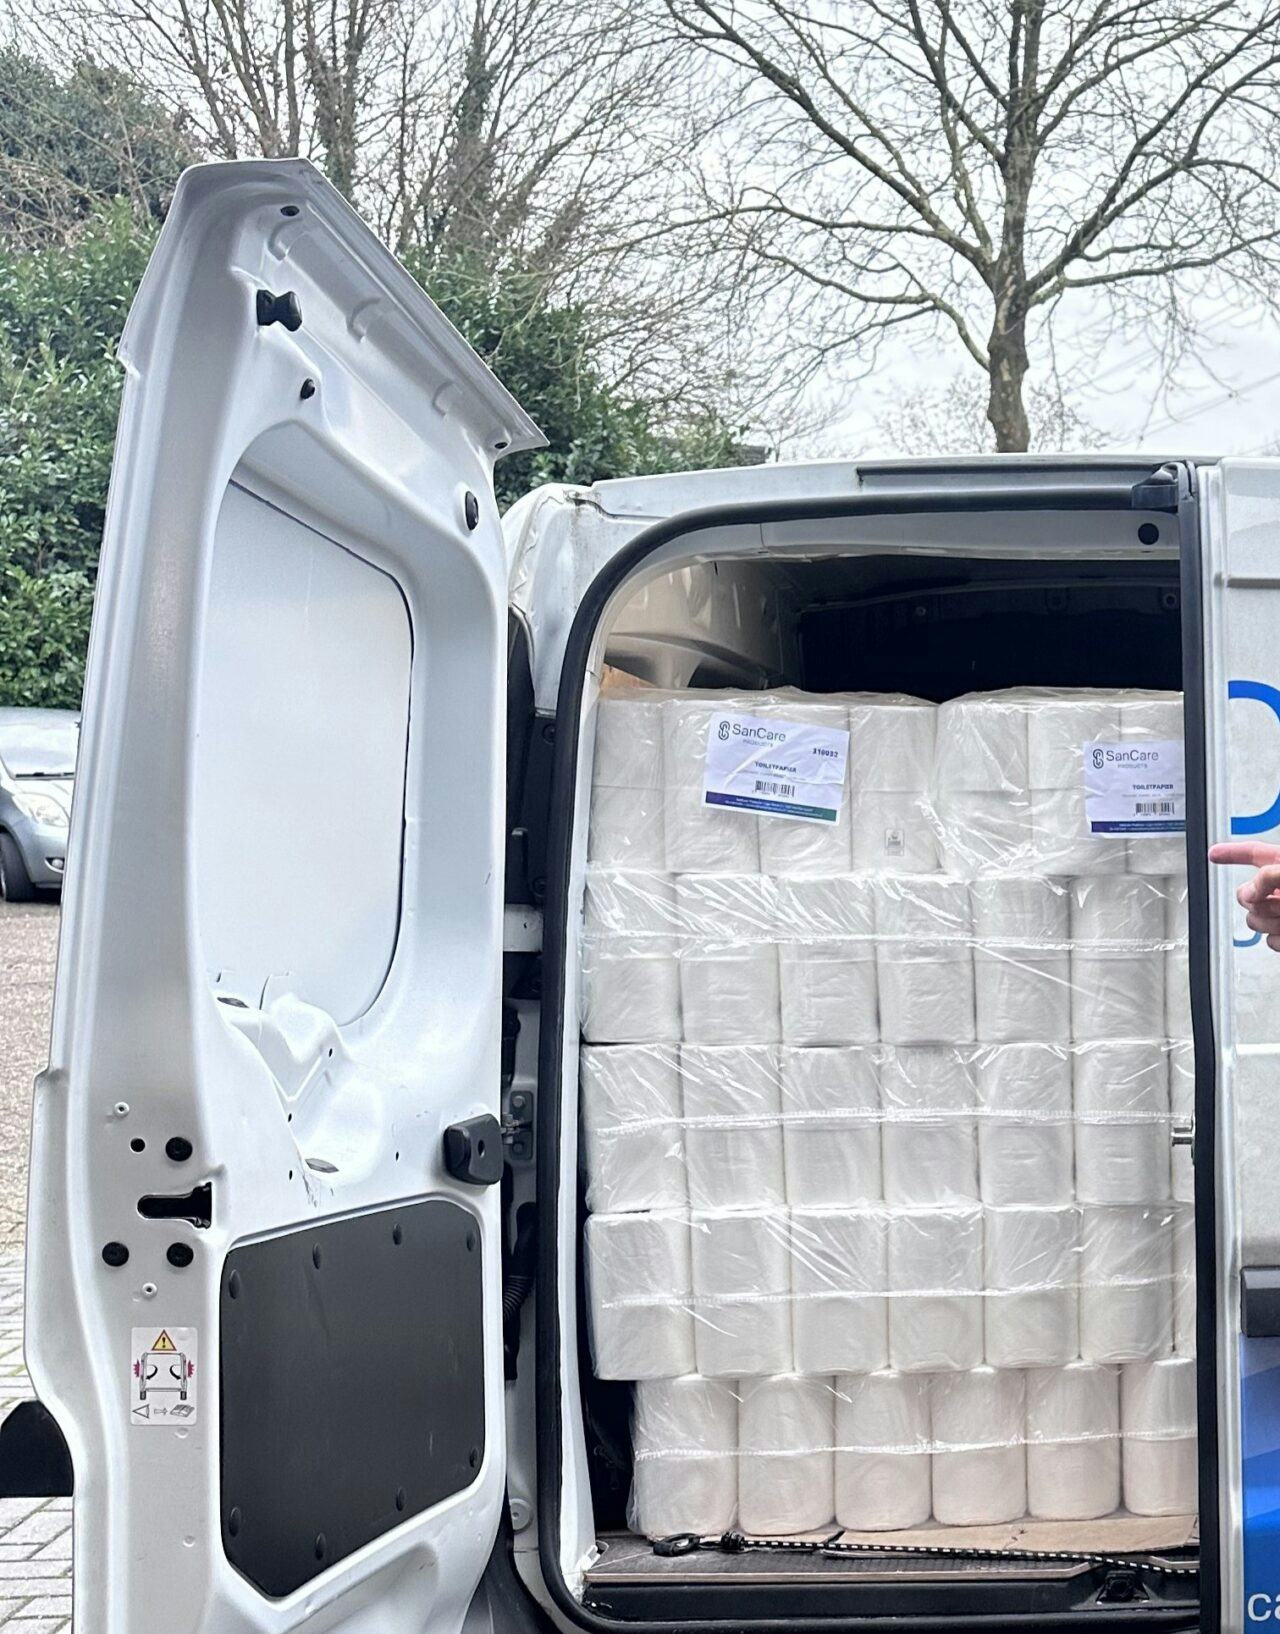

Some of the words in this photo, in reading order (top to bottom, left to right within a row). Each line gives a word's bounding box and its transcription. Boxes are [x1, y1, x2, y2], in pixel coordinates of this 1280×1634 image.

[732, 723, 786, 742] SanCare
[1106, 749, 1159, 762] SanCare
[754, 761, 797, 773] TOILETPAPIER
